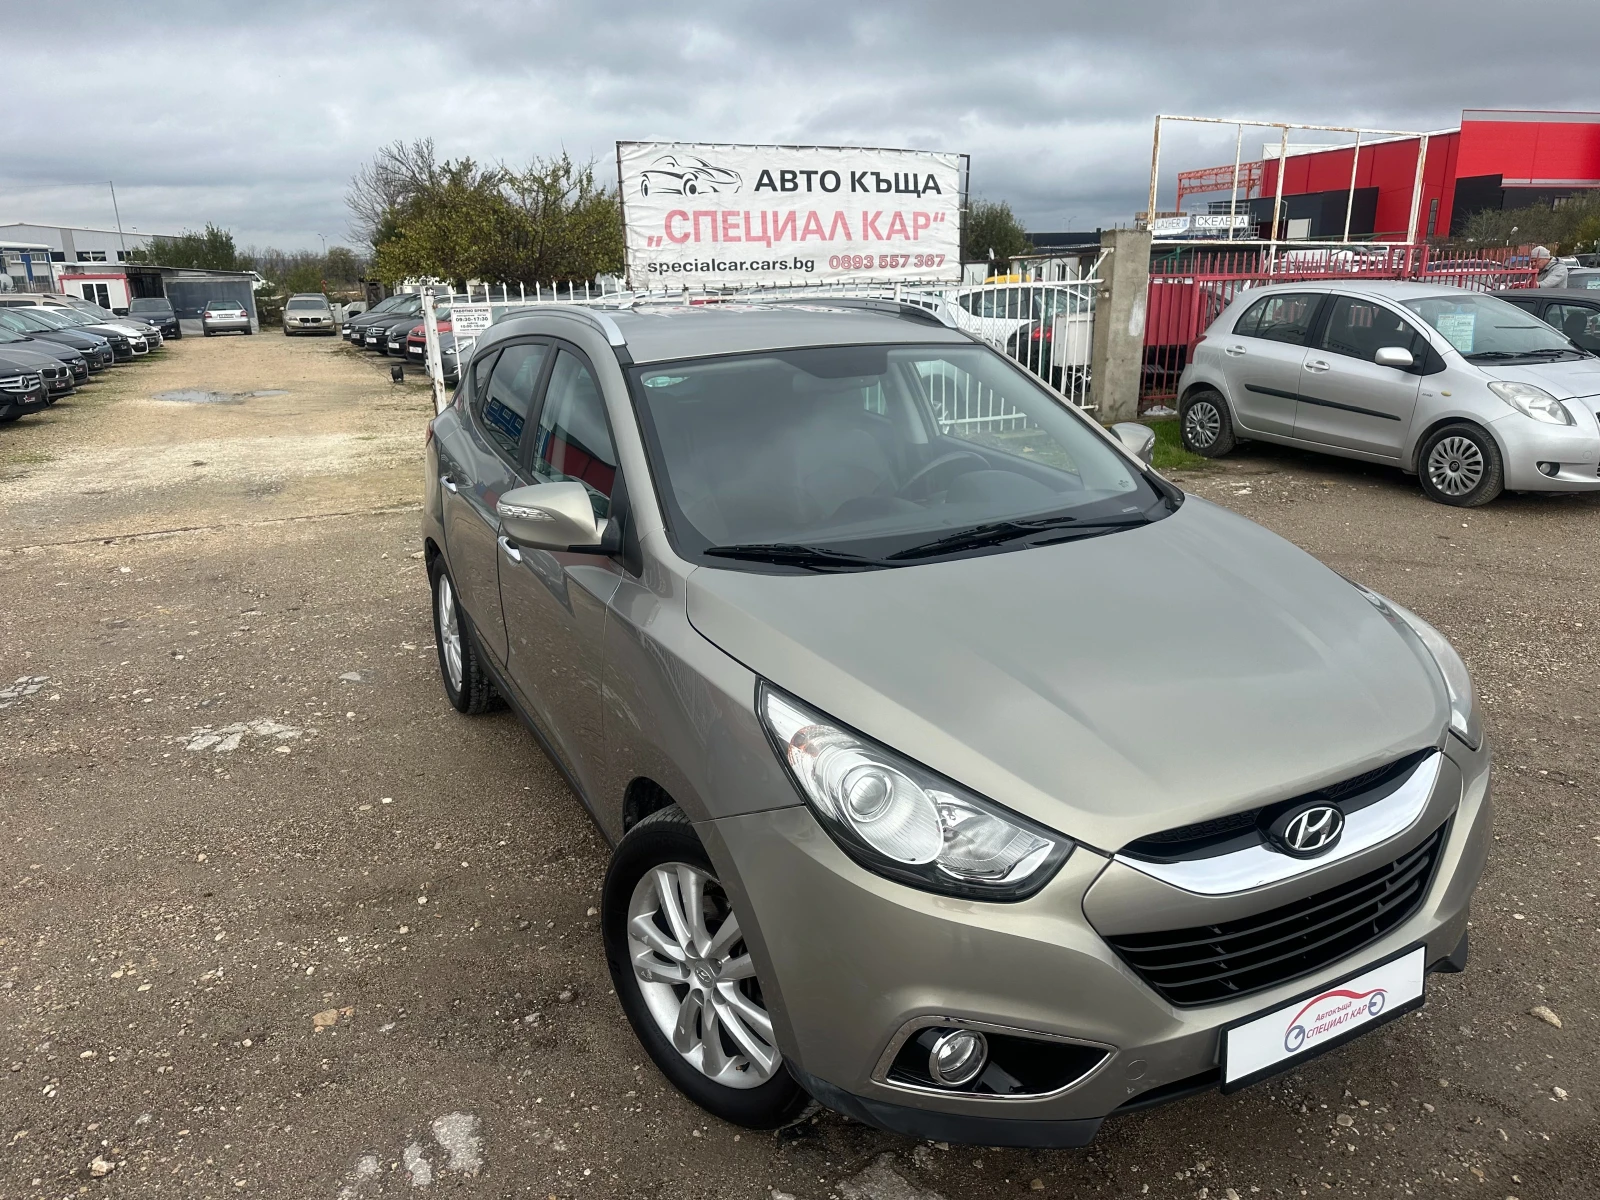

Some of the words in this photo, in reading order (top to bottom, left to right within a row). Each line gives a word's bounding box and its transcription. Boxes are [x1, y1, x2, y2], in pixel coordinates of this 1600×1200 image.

[754, 169, 841, 193] АВТО
[850, 170, 942, 198] КЪЩА
[647, 256, 815, 275] specialcar.cars.bg
[828, 254, 874, 269] 0893
[878, 254, 910, 268] 557
[913, 253, 946, 268] 367
[1306, 1011, 1349, 1039] СПЕЦИАЛ
[1349, 1004, 1367, 1020] КАР
[1314, 1001, 1352, 1022] Автокъща
